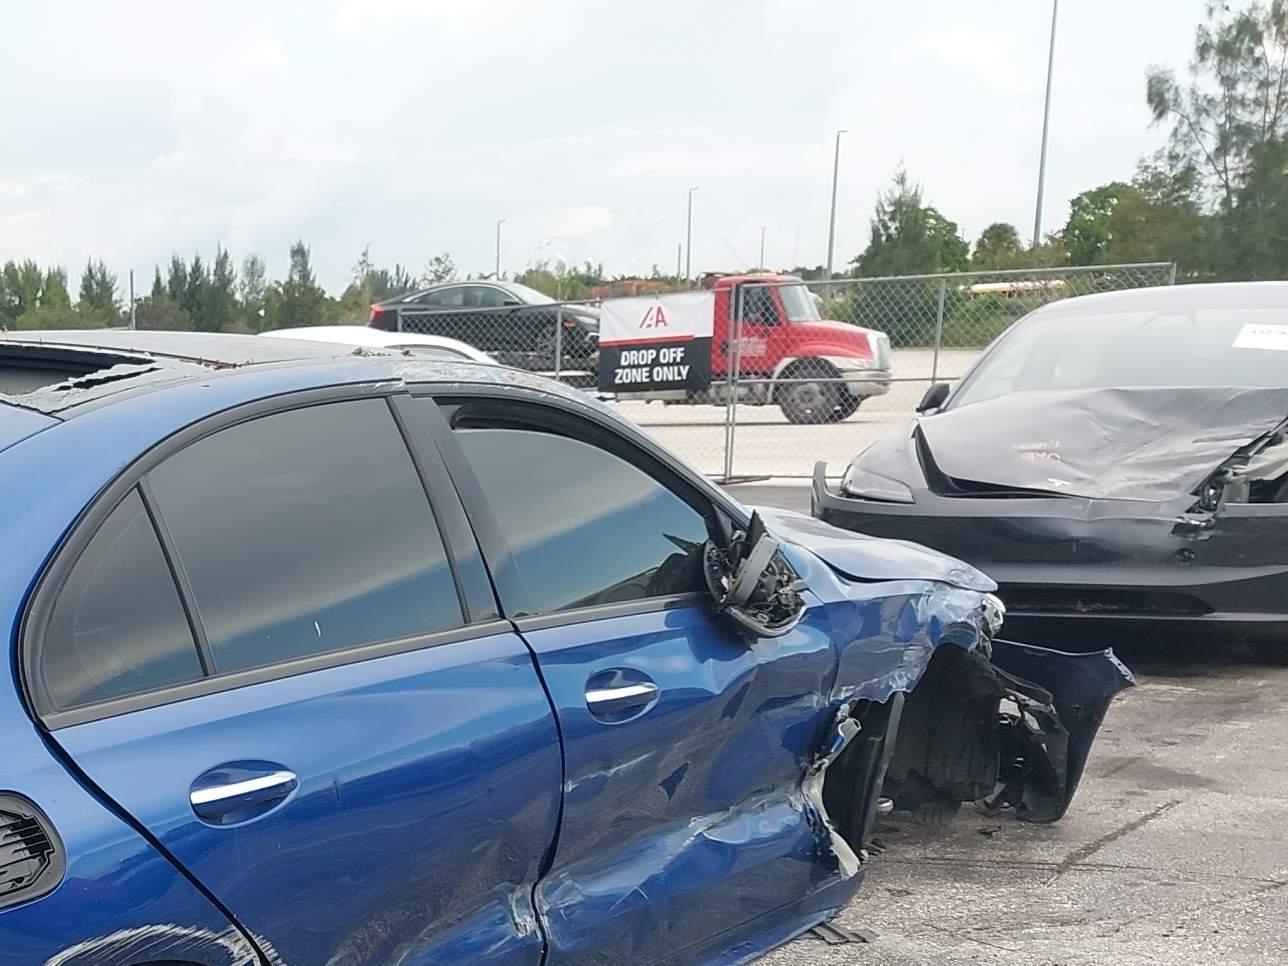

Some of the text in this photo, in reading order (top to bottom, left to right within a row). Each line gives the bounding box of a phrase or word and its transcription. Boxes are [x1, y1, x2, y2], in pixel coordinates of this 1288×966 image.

[620, 347, 685, 366] DROP OFF
[614, 365, 690, 384] ZONE ONLY
